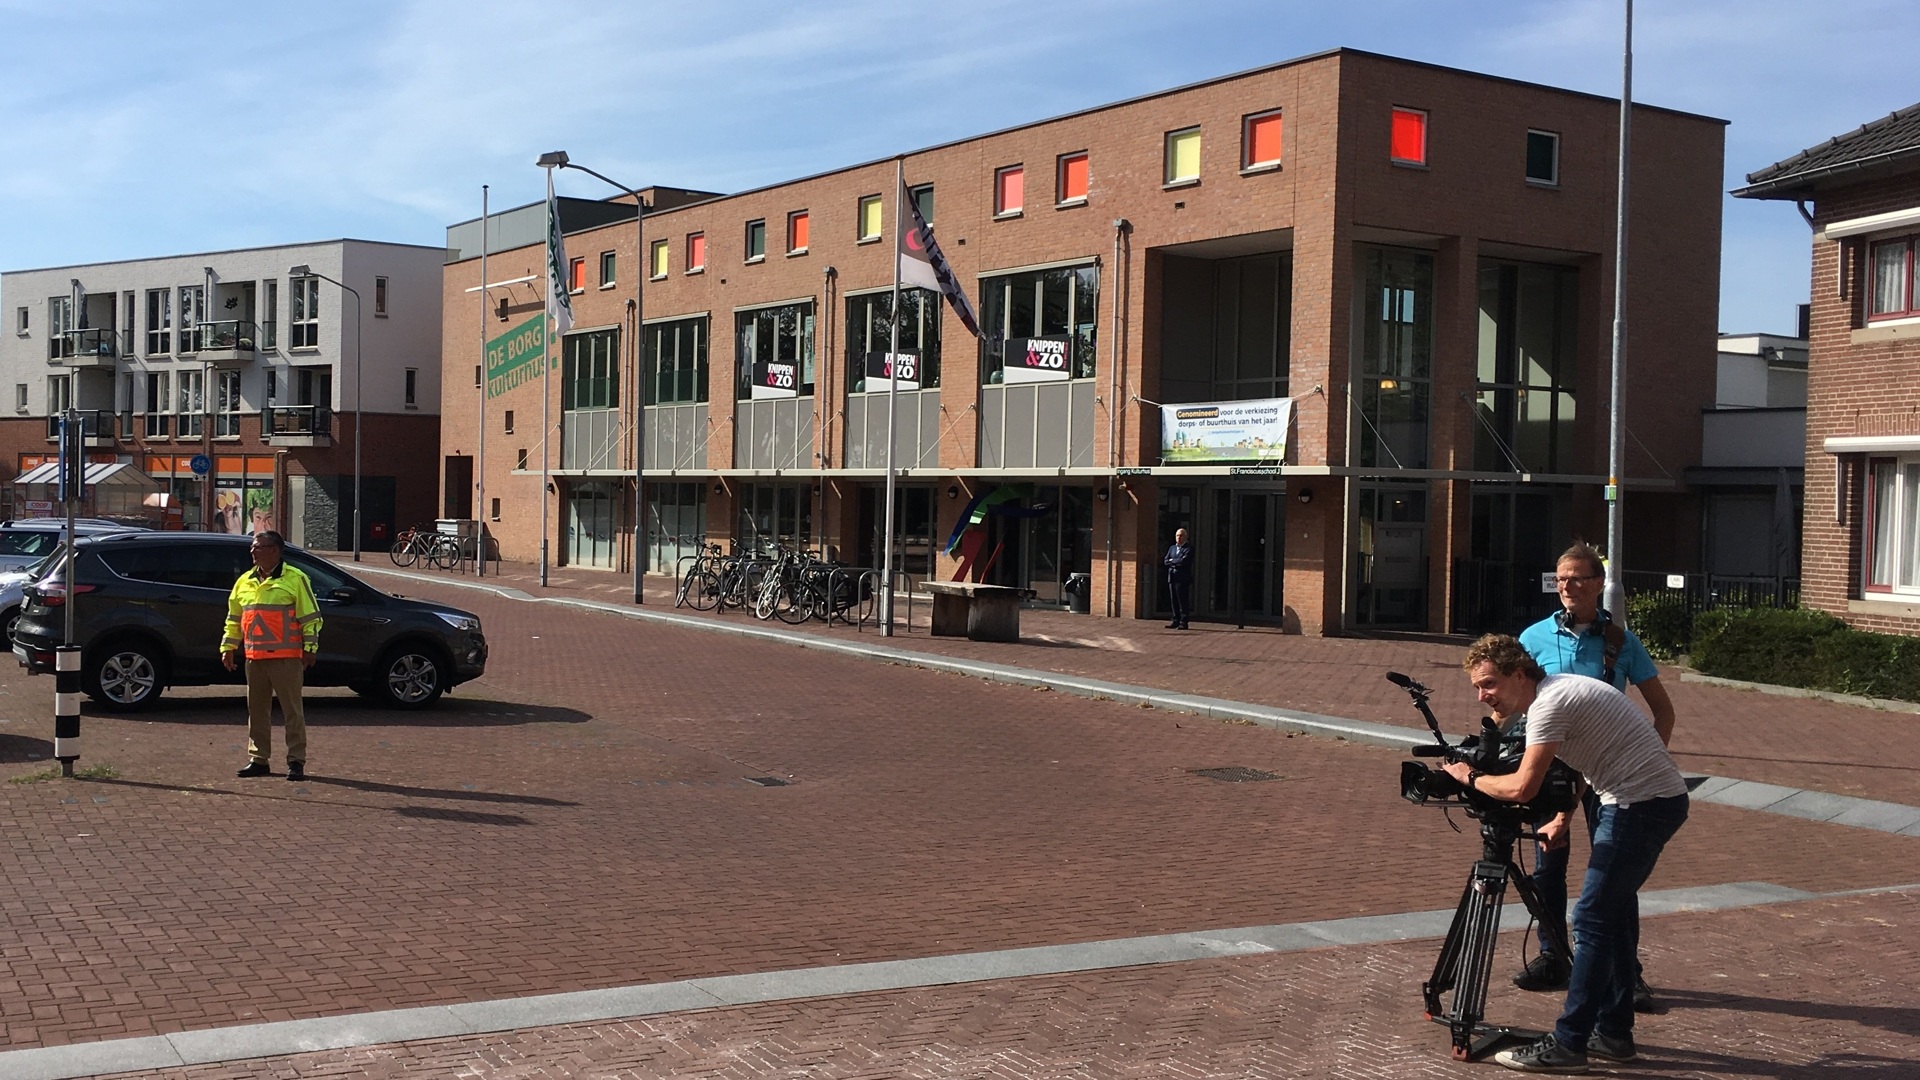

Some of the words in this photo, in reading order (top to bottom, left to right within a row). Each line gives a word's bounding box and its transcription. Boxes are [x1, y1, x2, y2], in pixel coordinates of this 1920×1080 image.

[489, 346, 505, 370] DE
[508, 326, 542, 360] BORG
[1027, 339, 1064, 354] KNIPPEN
[884, 352, 916, 366] KPPEN
[768, 363, 793, 375] KNIPPEN
[1177, 409, 1218, 419] Genomineerd
[1245, 407, 1278, 415] verkiezing
[1178, 420, 1197, 428] dorps-
[1206, 418, 1237, 426] buurthuis
[1251, 417, 1262, 425] het
[1263, 417, 1278, 426] jaar!
